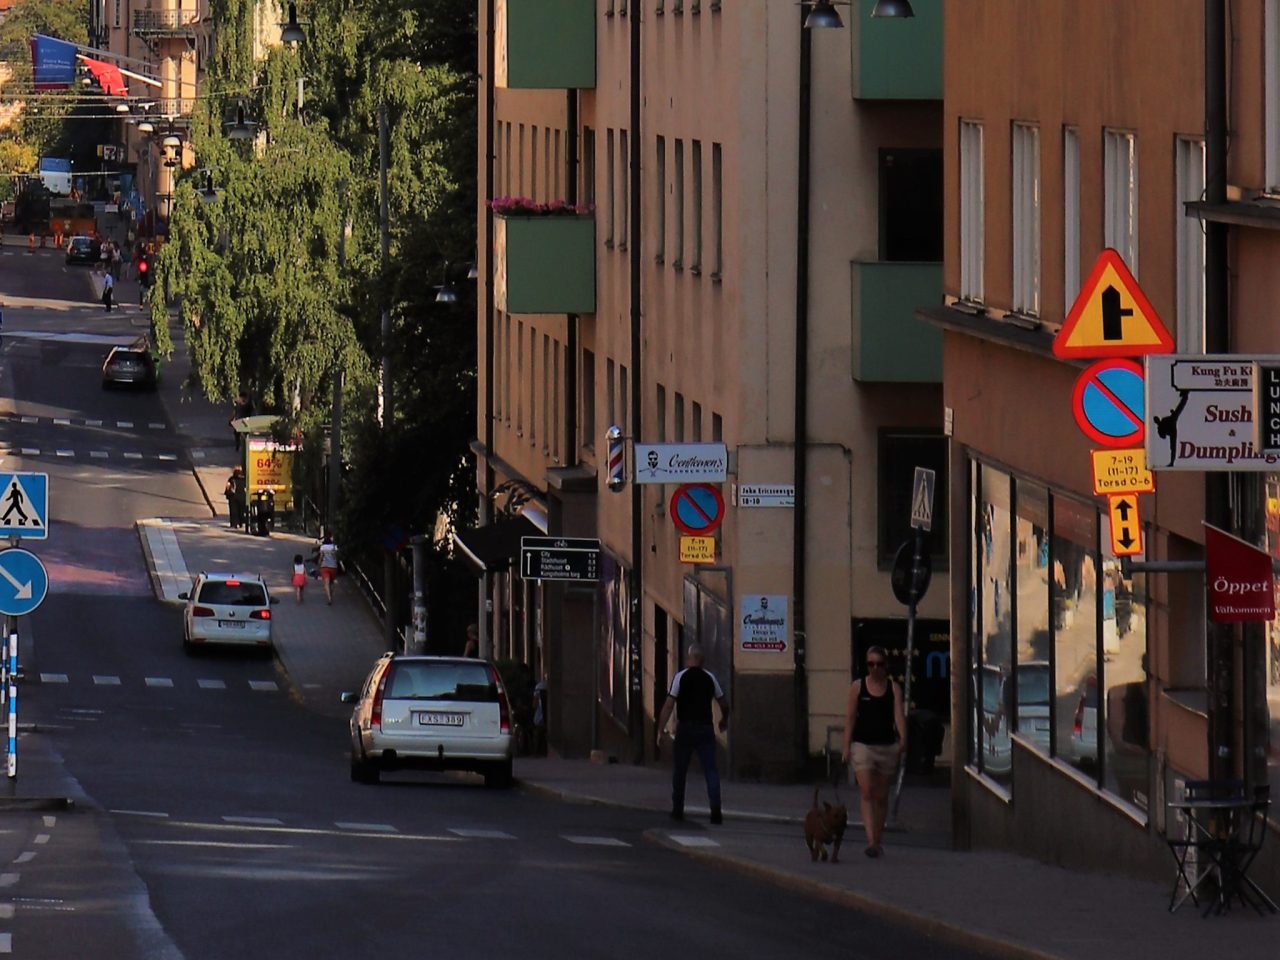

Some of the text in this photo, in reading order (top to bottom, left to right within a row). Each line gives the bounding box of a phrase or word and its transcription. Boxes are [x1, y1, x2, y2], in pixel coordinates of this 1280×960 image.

[1191, 366, 1220, 378] Kung
[1223, 366, 1237, 376] Fu
[1228, 429, 1236, 437] &
[1178, 441, 1280, 464] Dumpli
[1111, 455, 1133, 465] 7-19
[1107, 465, 1139, 476] (11-17)
[1097, 478, 1127, 488] Torsd
[1214, 576, 1269, 595] Öppet
[1215, 606, 1271, 614] Välkommen
